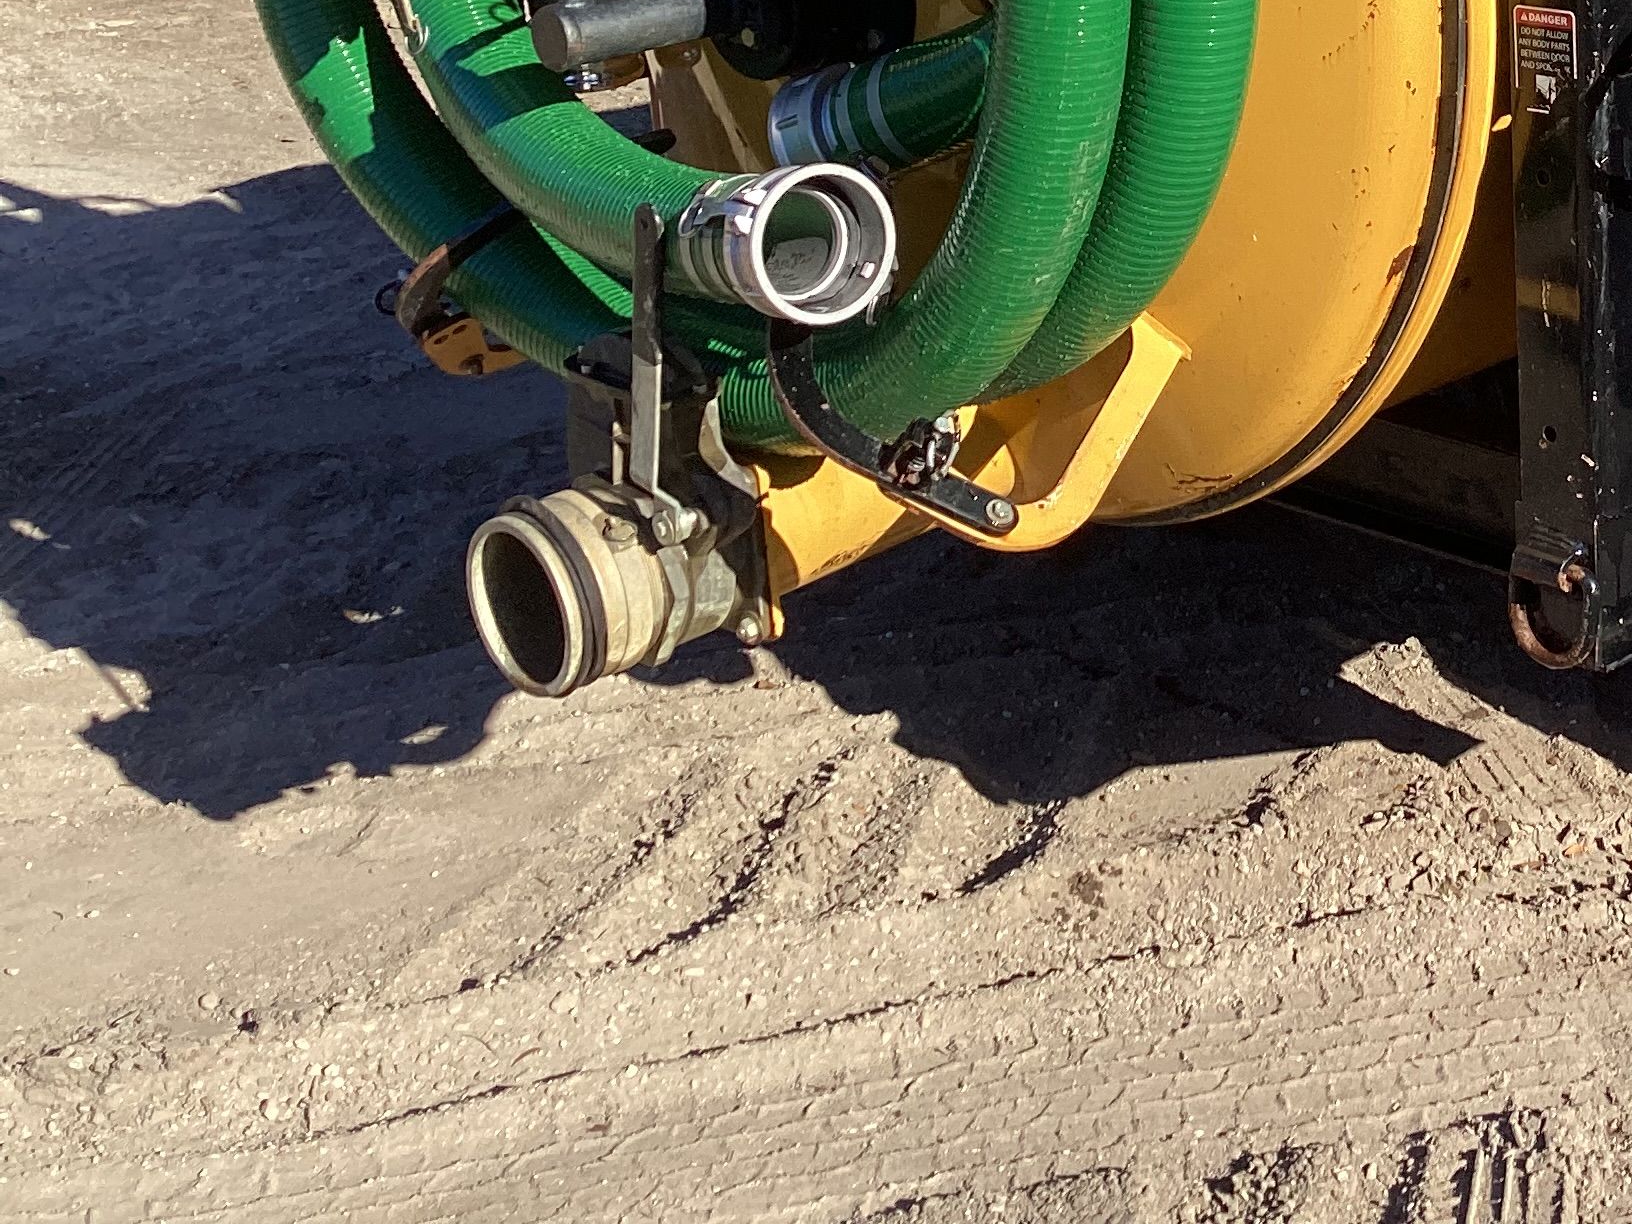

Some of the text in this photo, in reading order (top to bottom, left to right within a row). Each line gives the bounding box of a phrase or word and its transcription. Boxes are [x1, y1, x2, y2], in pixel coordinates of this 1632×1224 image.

[1528, 13, 1568, 26] DANGER
[1532, 28, 1545, 36] NOT
[1546, 30, 1569, 40] ALLOW
[1518, 38, 1571, 52] ANY BODY PARTS
[1520, 49, 1571, 63] BETWEEN DOOR
[1520, 60, 1535, 69] AND
